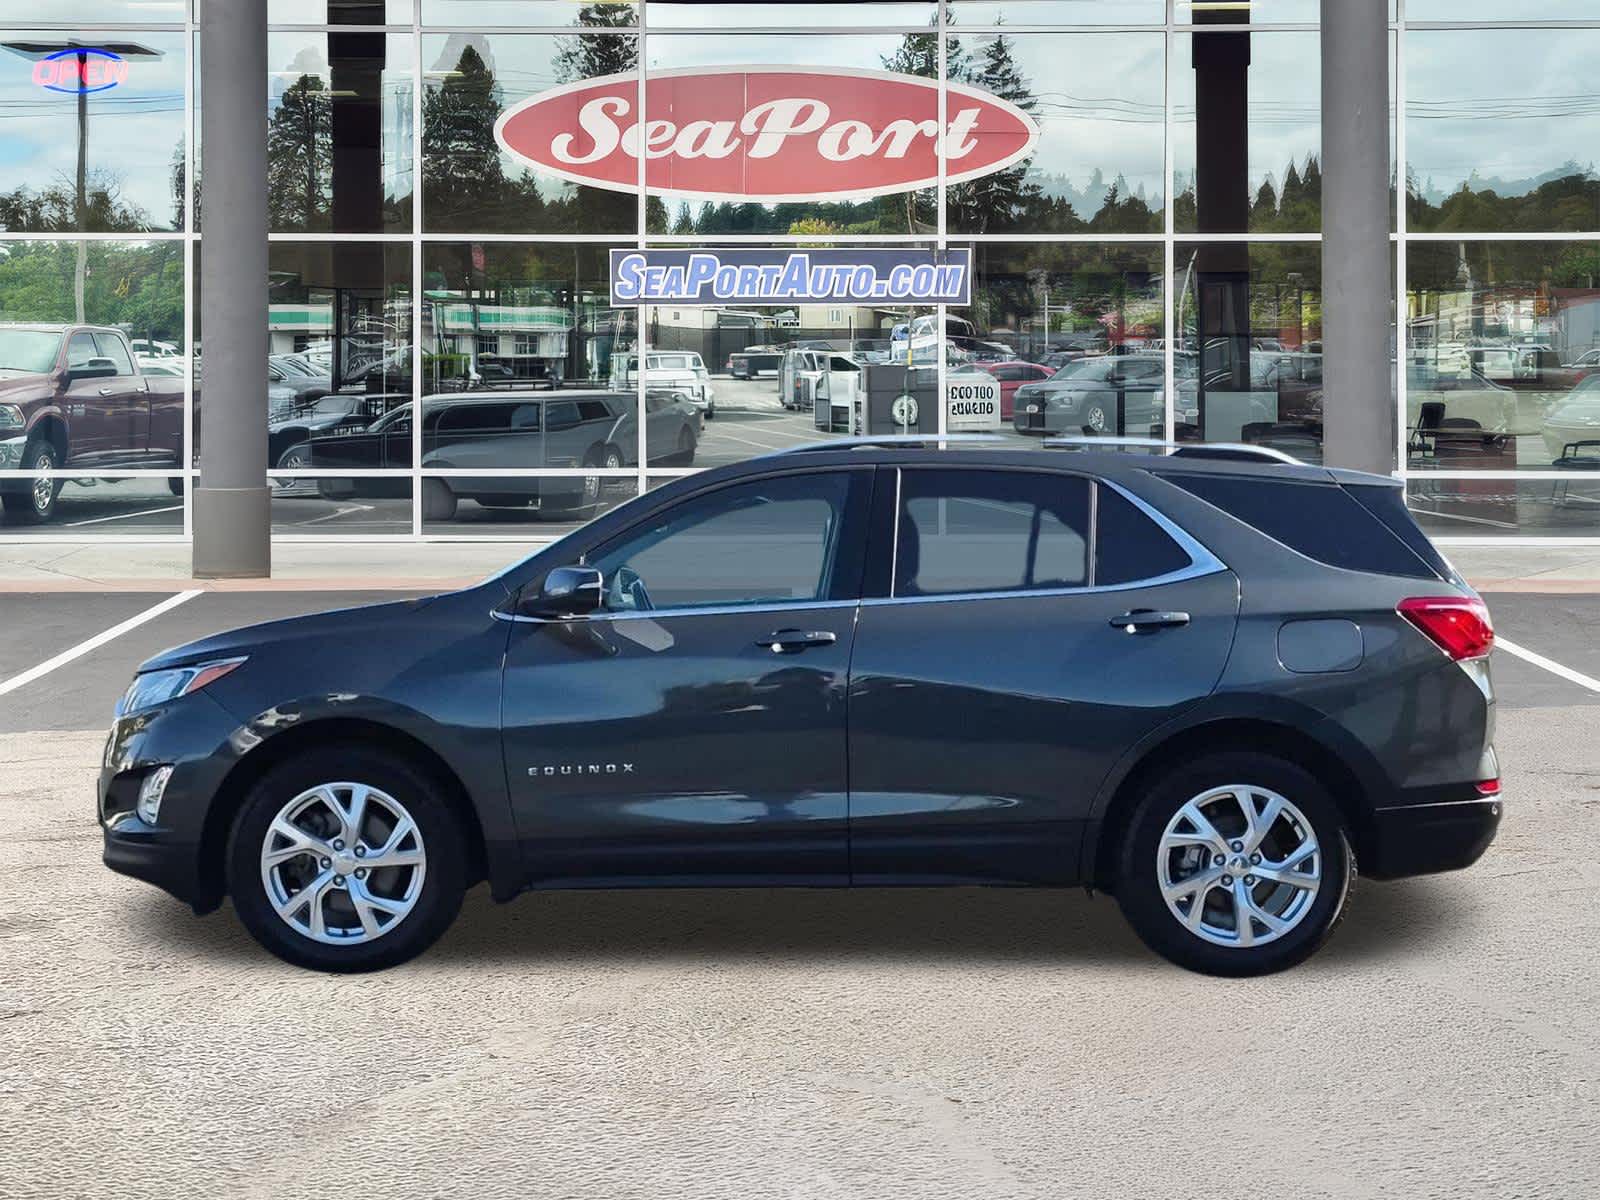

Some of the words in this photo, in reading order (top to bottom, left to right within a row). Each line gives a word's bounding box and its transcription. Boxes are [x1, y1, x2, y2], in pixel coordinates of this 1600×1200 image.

[32, 59, 129, 87] OPEN
[551, 97, 981, 164] SeaPort
[527, 763, 633, 776] EQUINOX
